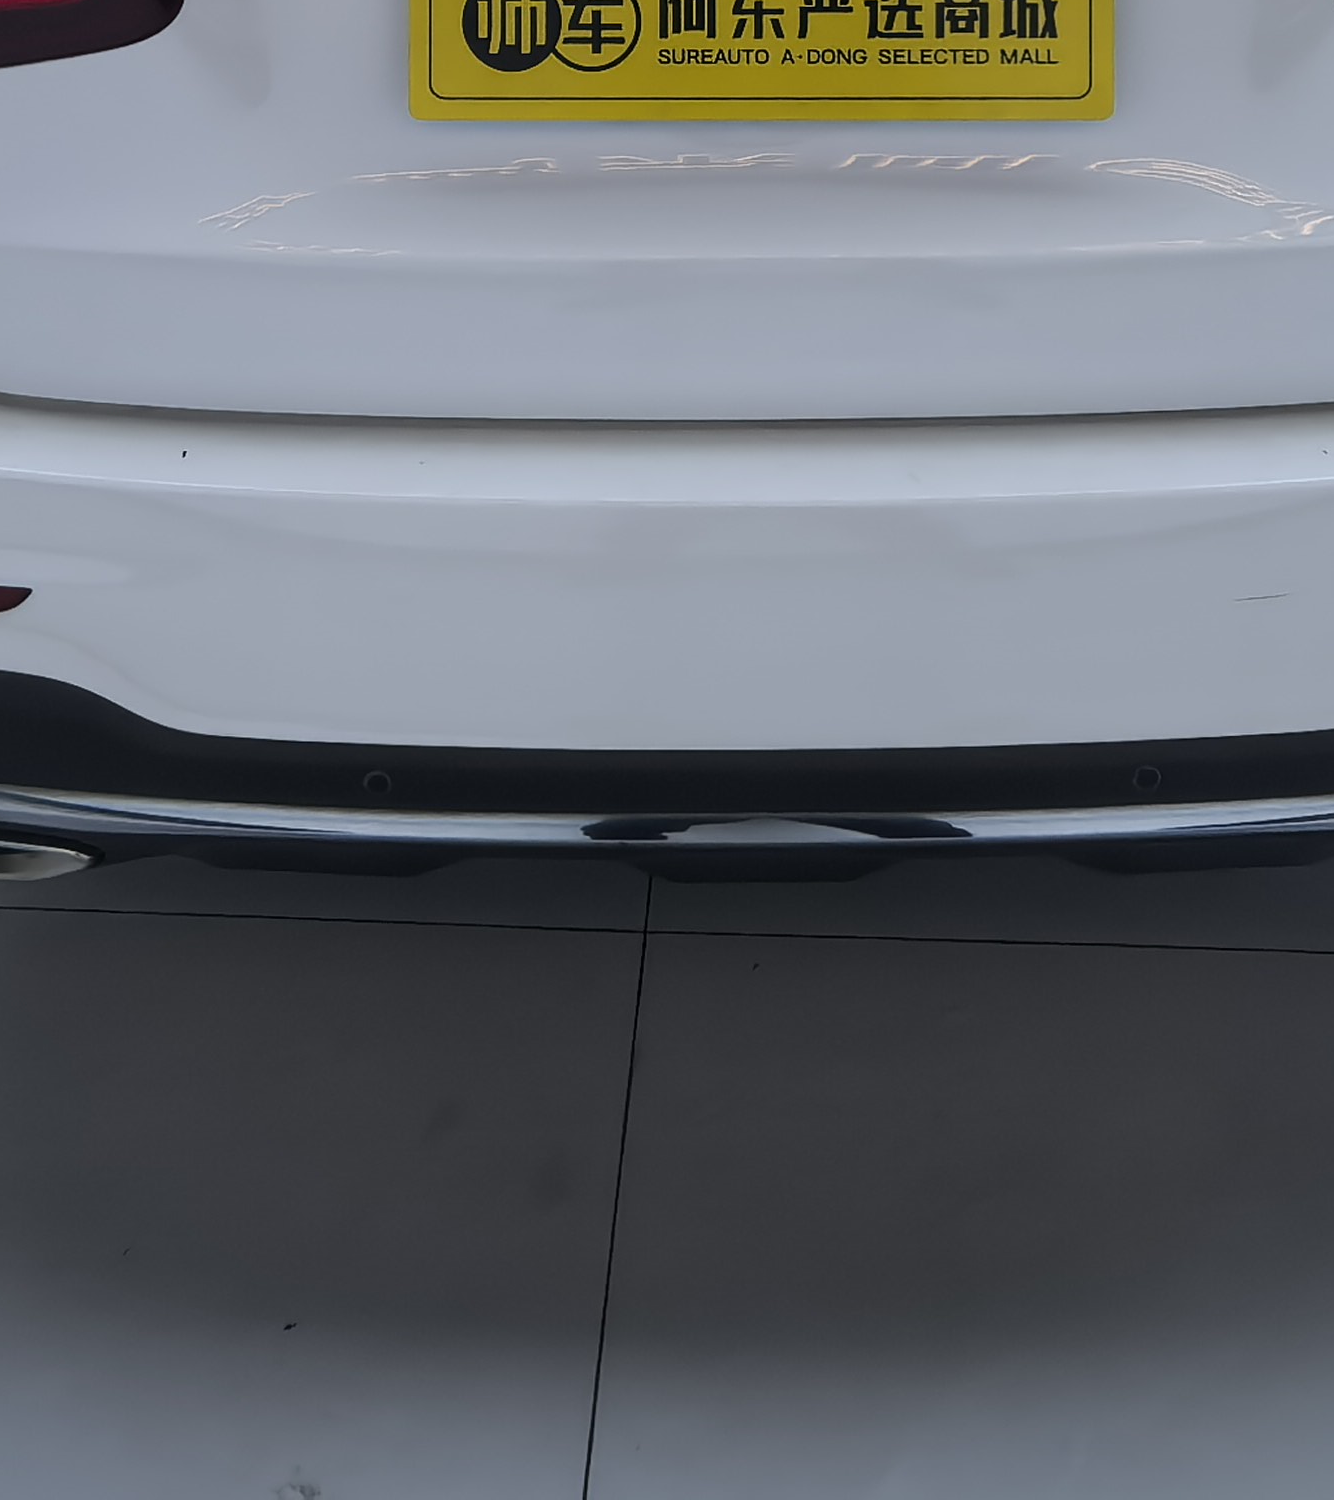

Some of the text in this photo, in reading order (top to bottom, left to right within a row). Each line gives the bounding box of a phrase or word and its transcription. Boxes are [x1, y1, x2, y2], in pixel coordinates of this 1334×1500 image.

[657, 47, 770, 66] SUREAUTO
[877, 47, 990, 66] SELECTED
[999, 47, 1060, 66] MALL
